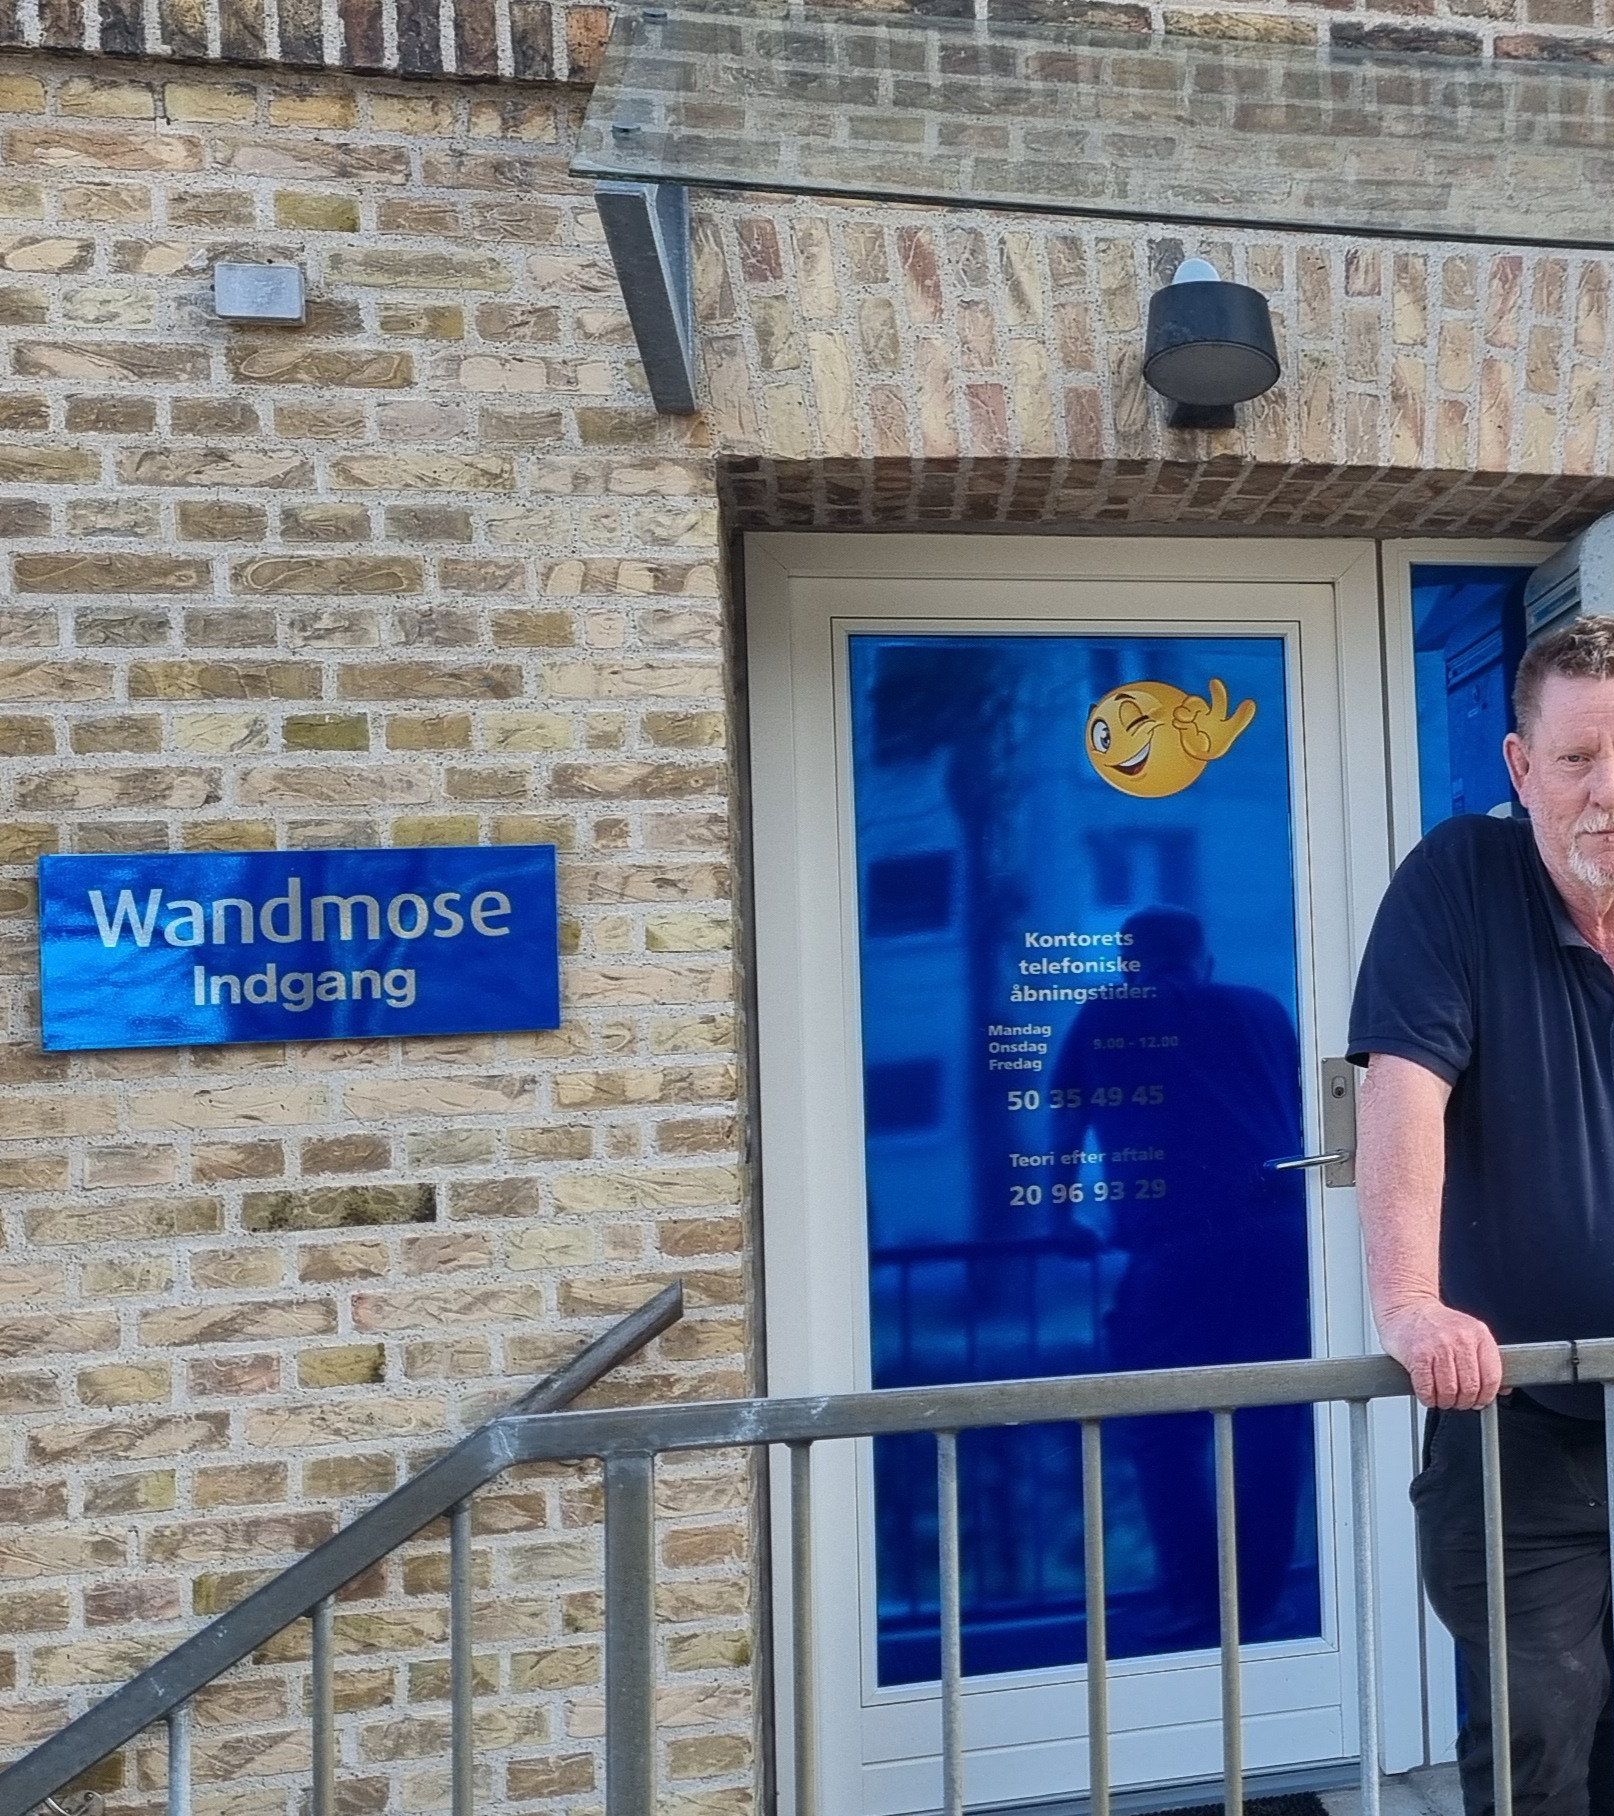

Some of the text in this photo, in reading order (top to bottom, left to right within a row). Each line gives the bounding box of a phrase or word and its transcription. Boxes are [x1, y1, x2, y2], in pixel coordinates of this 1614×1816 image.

[88, 877, 512, 948] Wandmose
[1024, 932, 1134, 948] Kontorets
[1019, 955, 1141, 975] telefoniske
[193, 962, 417, 1012] Indgang
[1009, 983, 1157, 1004] åbningstider:
[988, 1023, 1052, 1037] Mandag
[988, 1041, 1048, 1054] Onsdag
[1139, 1036, 1179, 1049] 12.00
[988, 1058, 1043, 1072] Fredag
[1007, 1085, 1164, 1110] 50 35 49 45
[1009, 1147, 1165, 1167] Teori efter aftale
[1009, 1179, 1166, 1206] 20 96 93 29
